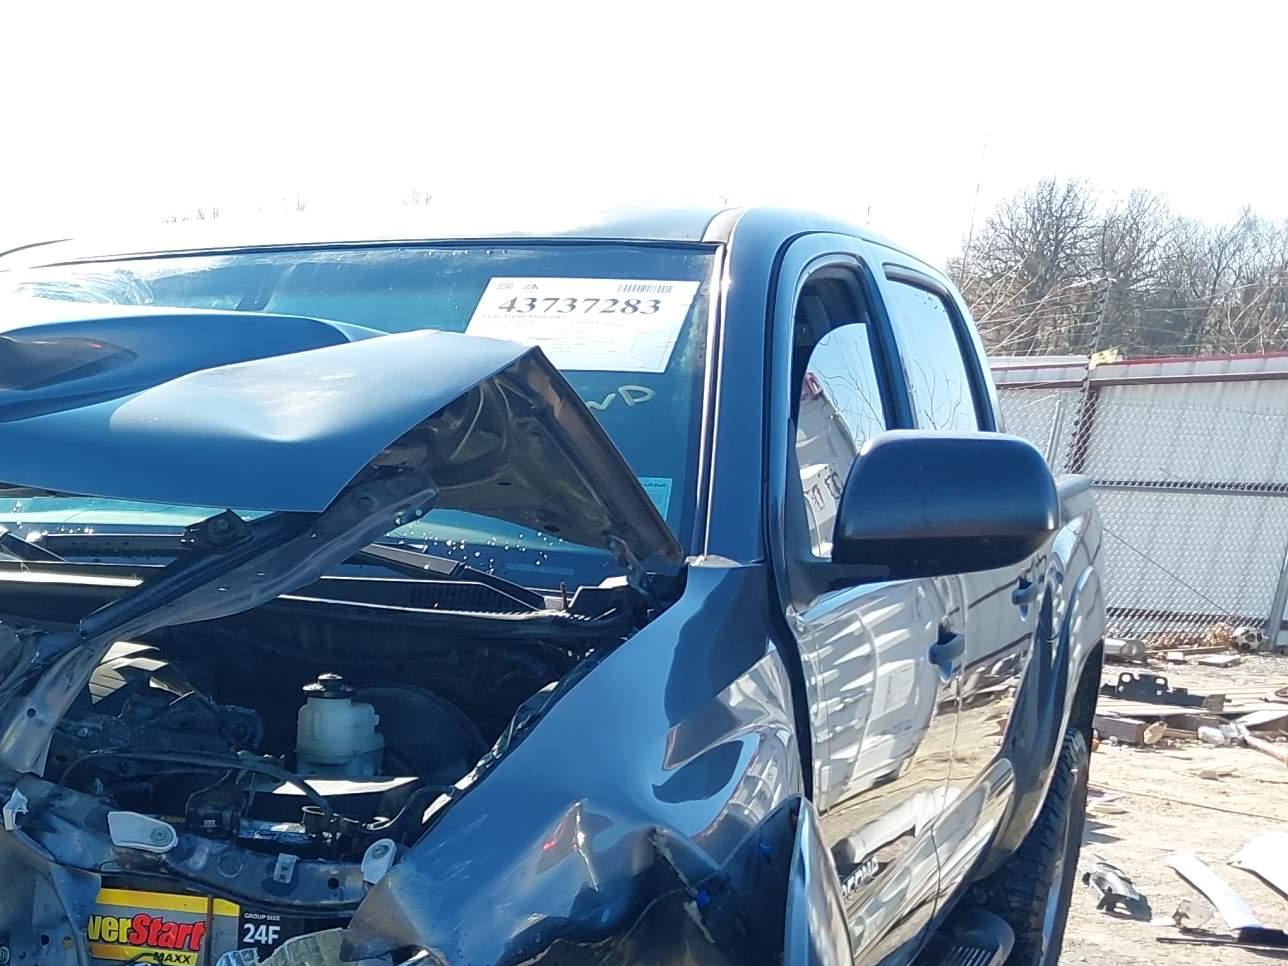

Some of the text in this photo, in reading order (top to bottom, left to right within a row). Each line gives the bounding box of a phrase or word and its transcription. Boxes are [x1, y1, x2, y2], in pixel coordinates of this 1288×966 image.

[498, 296, 661, 315] 43737283
[88, 912, 205, 951] verStart
[243, 923, 281, 945] 24F
[153, 952, 191, 964] MAXX
